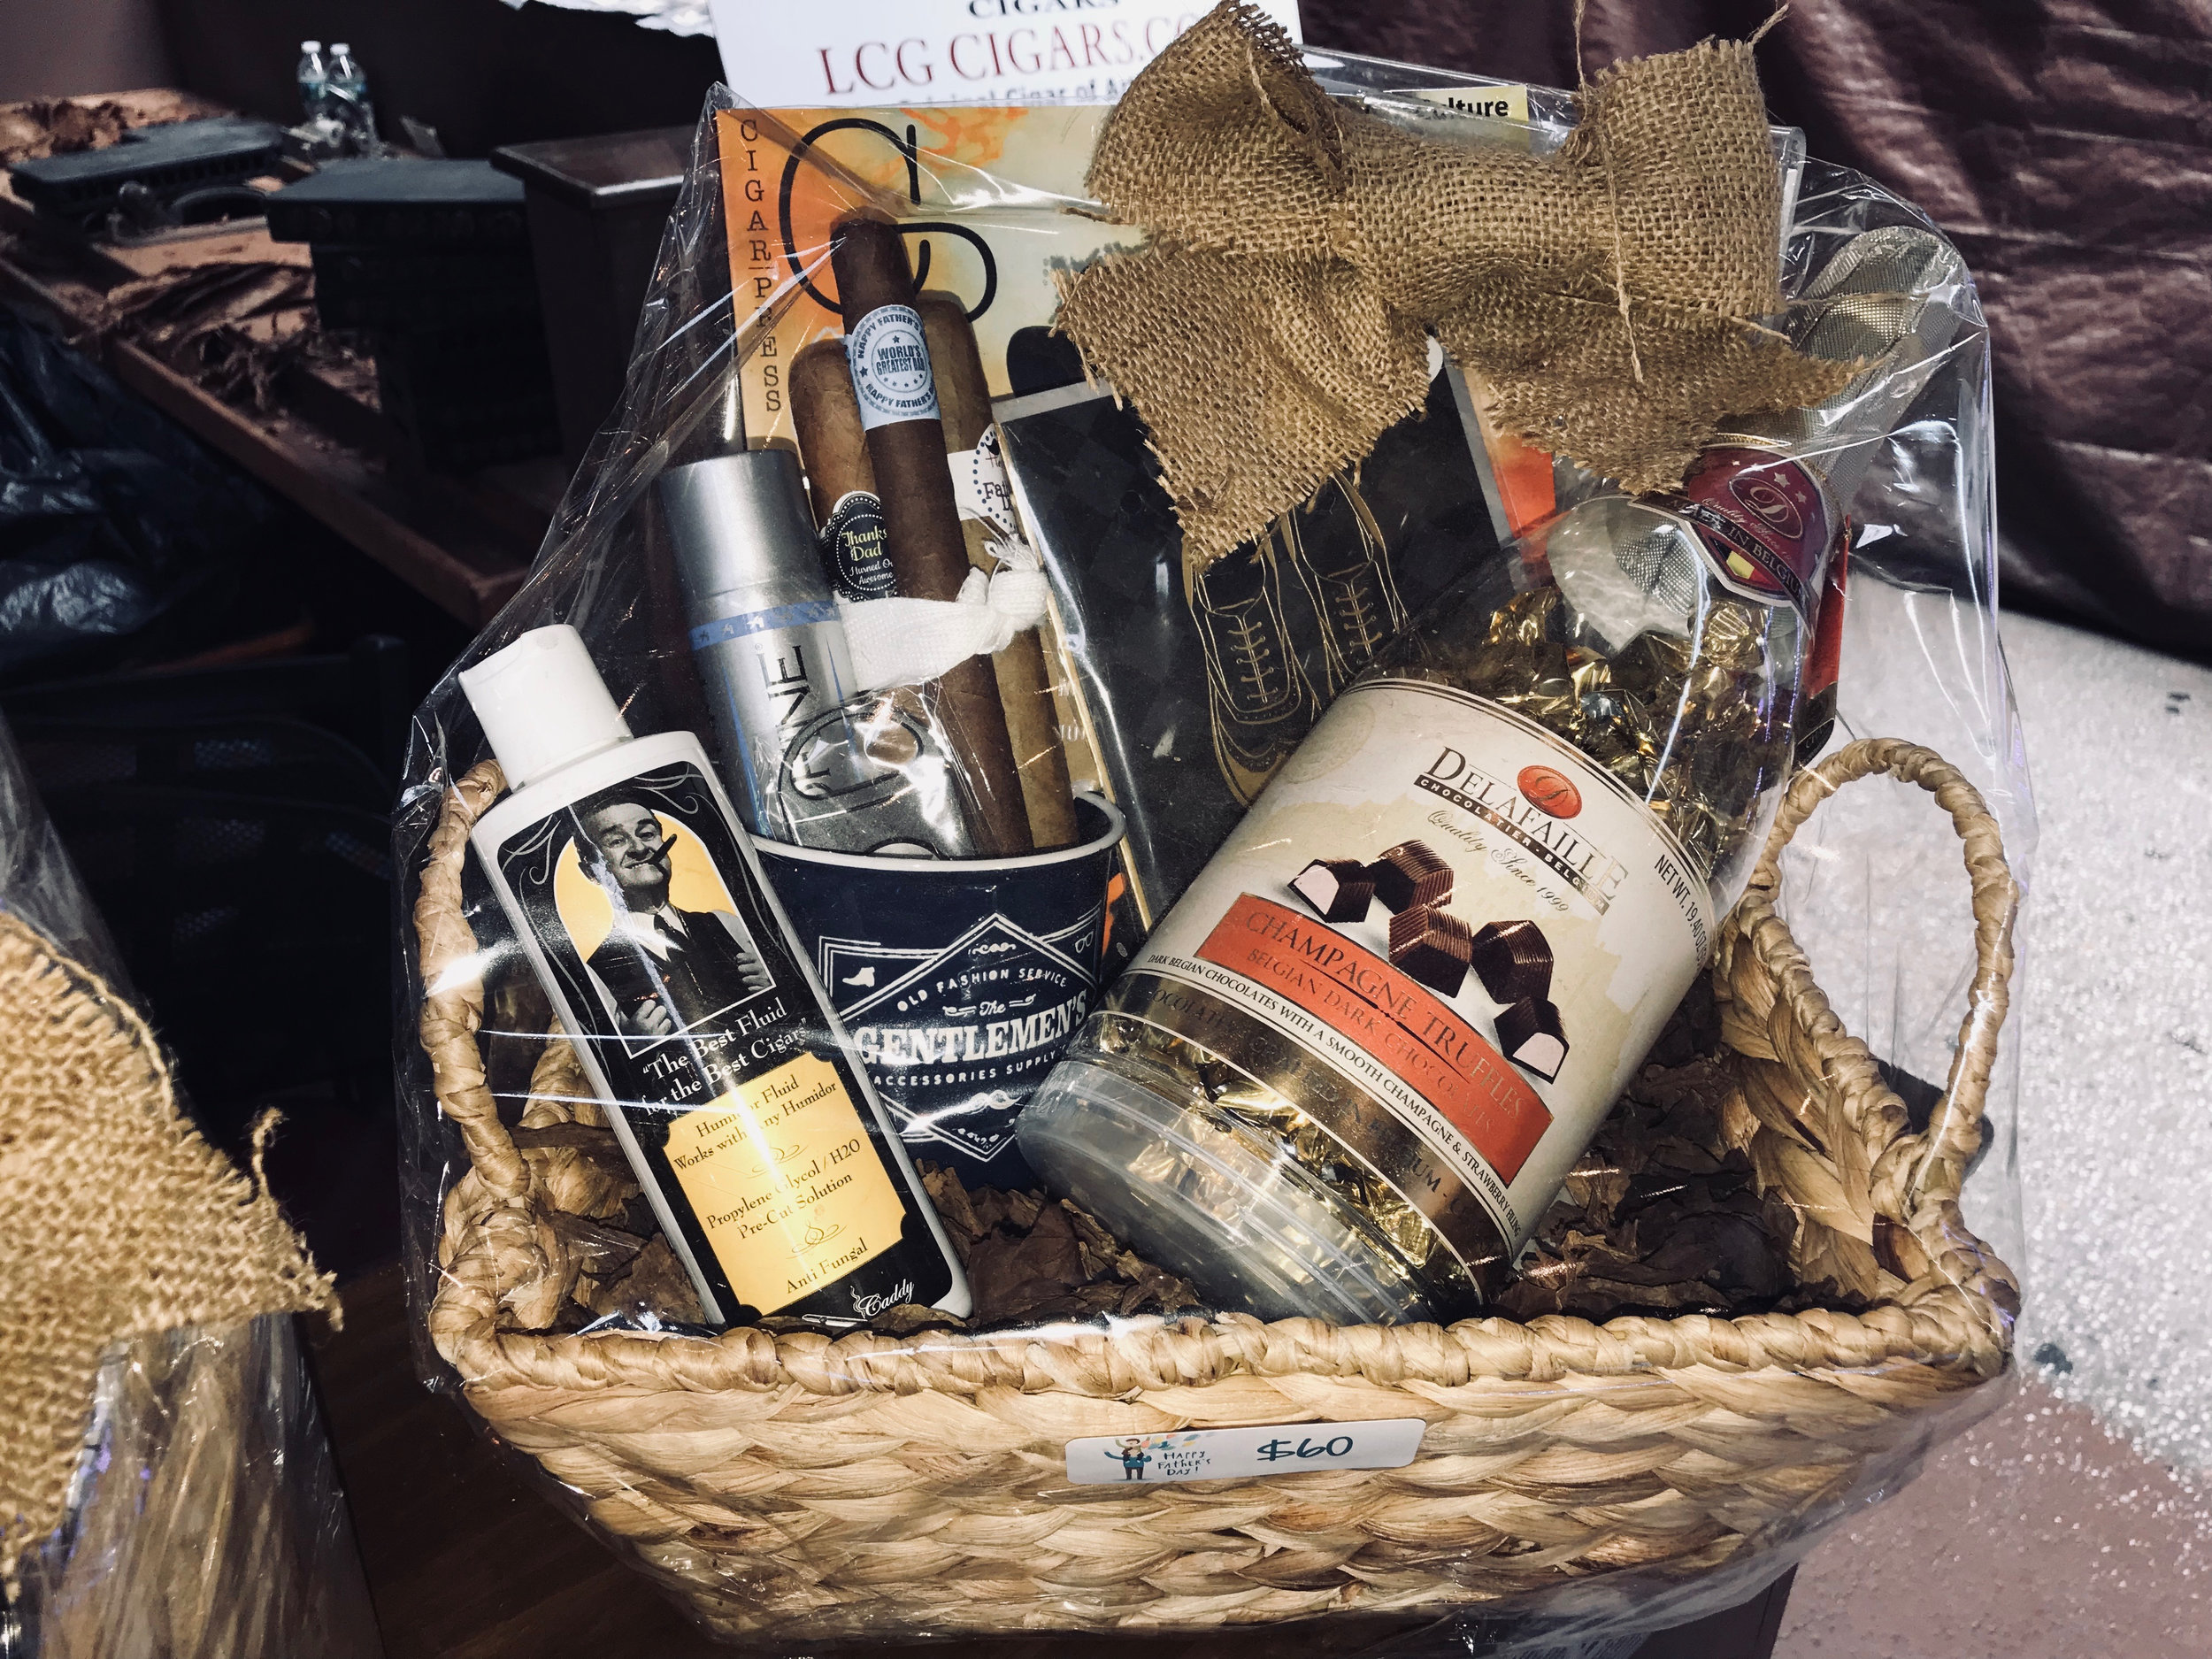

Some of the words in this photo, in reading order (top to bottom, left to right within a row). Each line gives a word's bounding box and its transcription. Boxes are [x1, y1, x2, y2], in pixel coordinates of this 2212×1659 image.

[816, 38, 933, 95] LCG
[740, 119, 772, 263] CIGAR
[857, 322, 878, 359] HAPPY
[878, 313, 920, 332] FATHER'S
[877, 344, 922, 361] WORLD'S
[876, 357, 913, 376] GREATEST
[865, 383, 895, 407] HAPPY
[895, 392, 932, 408] FATHER'S
[841, 525, 887, 547] Thanks
[850, 541, 883, 562] Dad
[1727, 526, 1749, 546] IN
[858, 571, 895, 586] Awesome
[1419, 778, 1532, 849] CHOCOLATIER
[1543, 852, 1607, 911] BELGIUM
[1424, 746, 1630, 902] DELAFAILLE
[1426, 810, 1489, 854] Quality
[1491, 848, 1537, 887] Since
[1537, 886, 1571, 913] 1999
[1654, 854, 1679, 886] NET
[1671, 876, 1691, 910] WT.
[896, 988, 929, 1013] OLD
[935, 968, 1010, 995] FASHION
[1018, 966, 1068, 988] SERVICE
[979, 999, 1007, 1018] The
[1245, 911, 1417, 1021] CHAMPAGNE
[1420, 1011, 1525, 1120] TRUFFLES
[1246, 948, 1323, 995] BELGIAN
[1324, 990, 1382, 1036] DARK
[689, 1029, 737, 1060] Best
[735, 996, 789, 1037] Fluid
[852, 987, 1088, 1065] GENTLEMEN'S
[670, 1077, 703, 1104] the
[702, 1052, 750, 1085] Best
[761, 1073, 801, 1105] Fluid
[872, 1067, 998, 1087] ACCESSORIES
[1005, 1049, 1056, 1076] SUPPLY
[1147, 954, 1169, 965] DARK
[1168, 956, 1206, 976] BELGIAN
[1204, 968, 1279, 1011] CHOCOLATES
[1279, 1004, 1316, 1033] WITH
[1313, 1029, 1324, 1041] A
[1325, 1036, 1383, 1084] SMOOTH
[1383, 1078, 1454, 1145] CHAMPAGNE
[1452, 1140, 1462, 1156] &
[1461, 1151, 1511, 1217] STRAWBERRY
[1506, 1204, 1523, 1238] FILLING
[673, 1146, 715, 1171] Works
[717, 1125, 749, 1151] with
[781, 1080, 838, 1118] Humidor
[706, 1190, 773, 1230] Propylene
[774, 1158, 822, 1194] Glycol
[829, 1138, 862, 1166] H2O
[736, 1203, 795, 1240] Pre-Cut
[795, 1172, 854, 1210] Solution
[785, 1268, 818, 1295] Anti
[818, 1235, 870, 1276] Fungal
[858, 1278, 915, 1317] Caddy
[1256, 1435, 1355, 1463] $60
